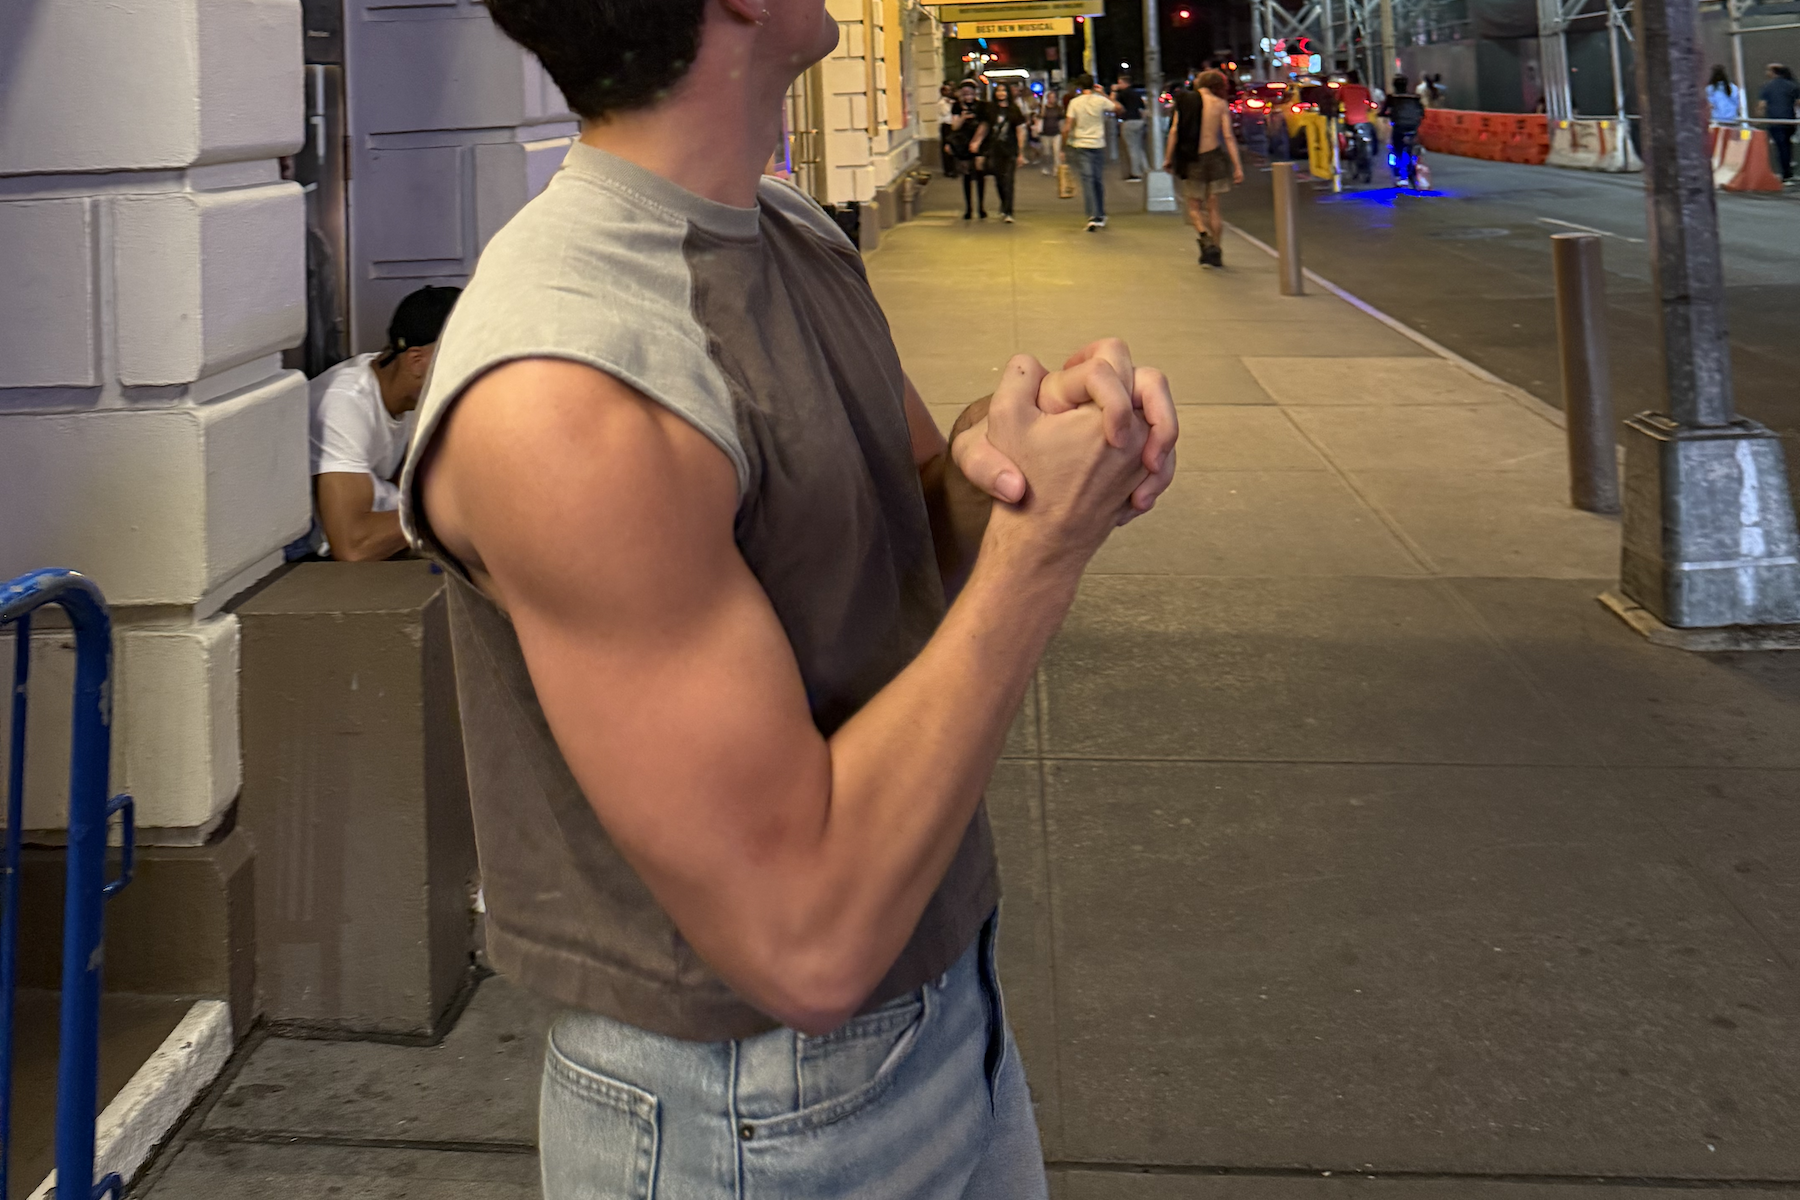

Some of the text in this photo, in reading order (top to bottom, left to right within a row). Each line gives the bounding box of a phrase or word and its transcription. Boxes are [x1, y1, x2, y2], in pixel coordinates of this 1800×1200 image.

[976, 25, 996, 34] BEST
[997, 24, 1015, 33] NEW
[1018, 22, 1054, 32] MUSICAL
